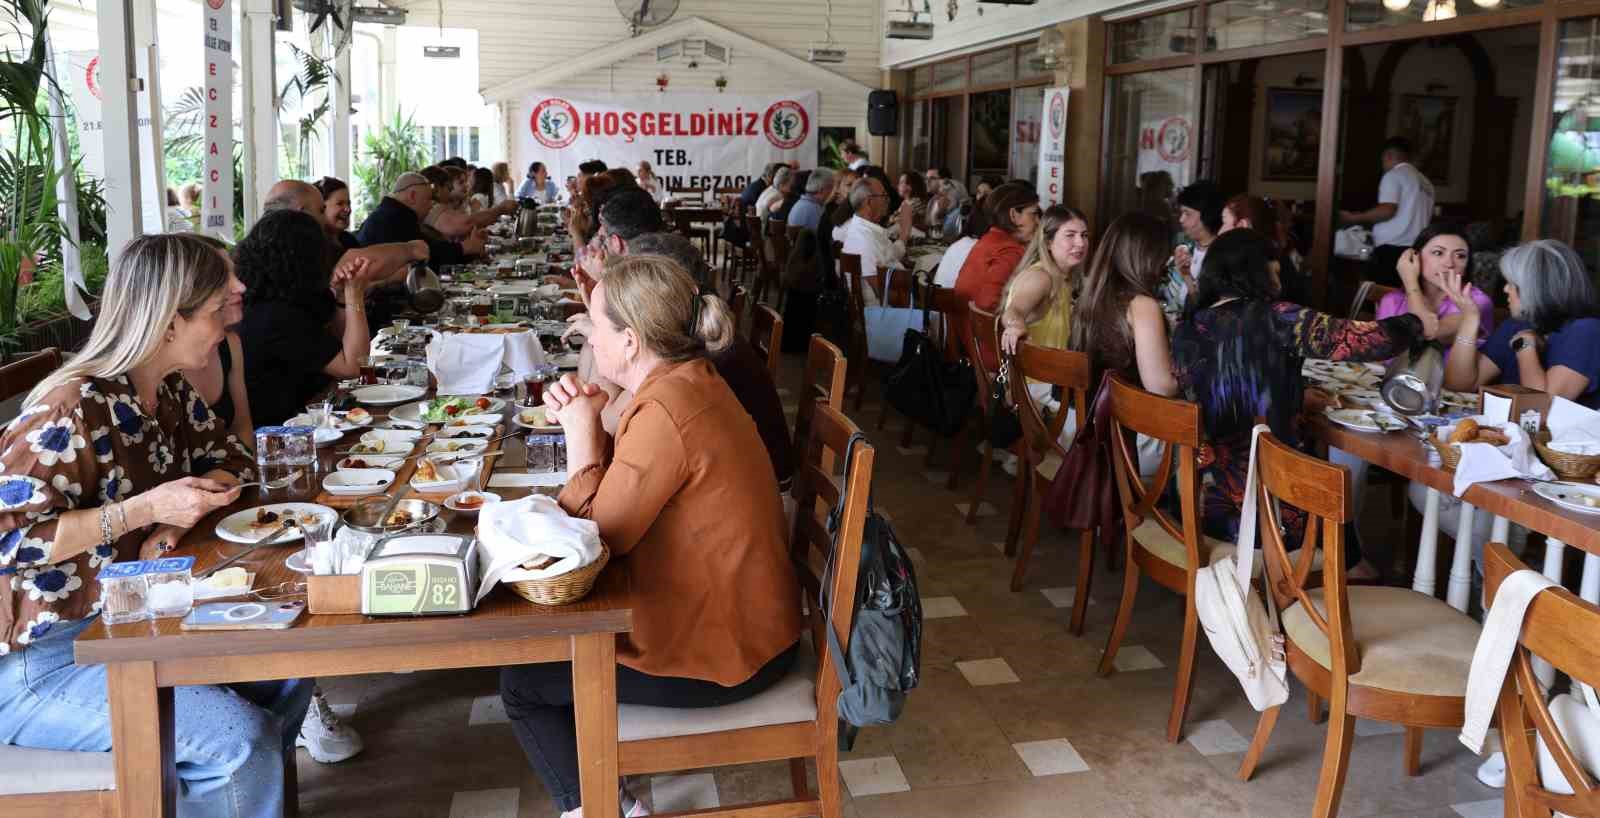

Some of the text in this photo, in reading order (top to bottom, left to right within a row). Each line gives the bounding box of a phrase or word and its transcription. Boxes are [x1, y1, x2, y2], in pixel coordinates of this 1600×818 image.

[209, 63, 219, 208] ECZACI
[584, 107, 760, 143] HOŞGELDİNİZ
[653, 149, 692, 167] TEB.
[432, 584, 456, 605] 82
